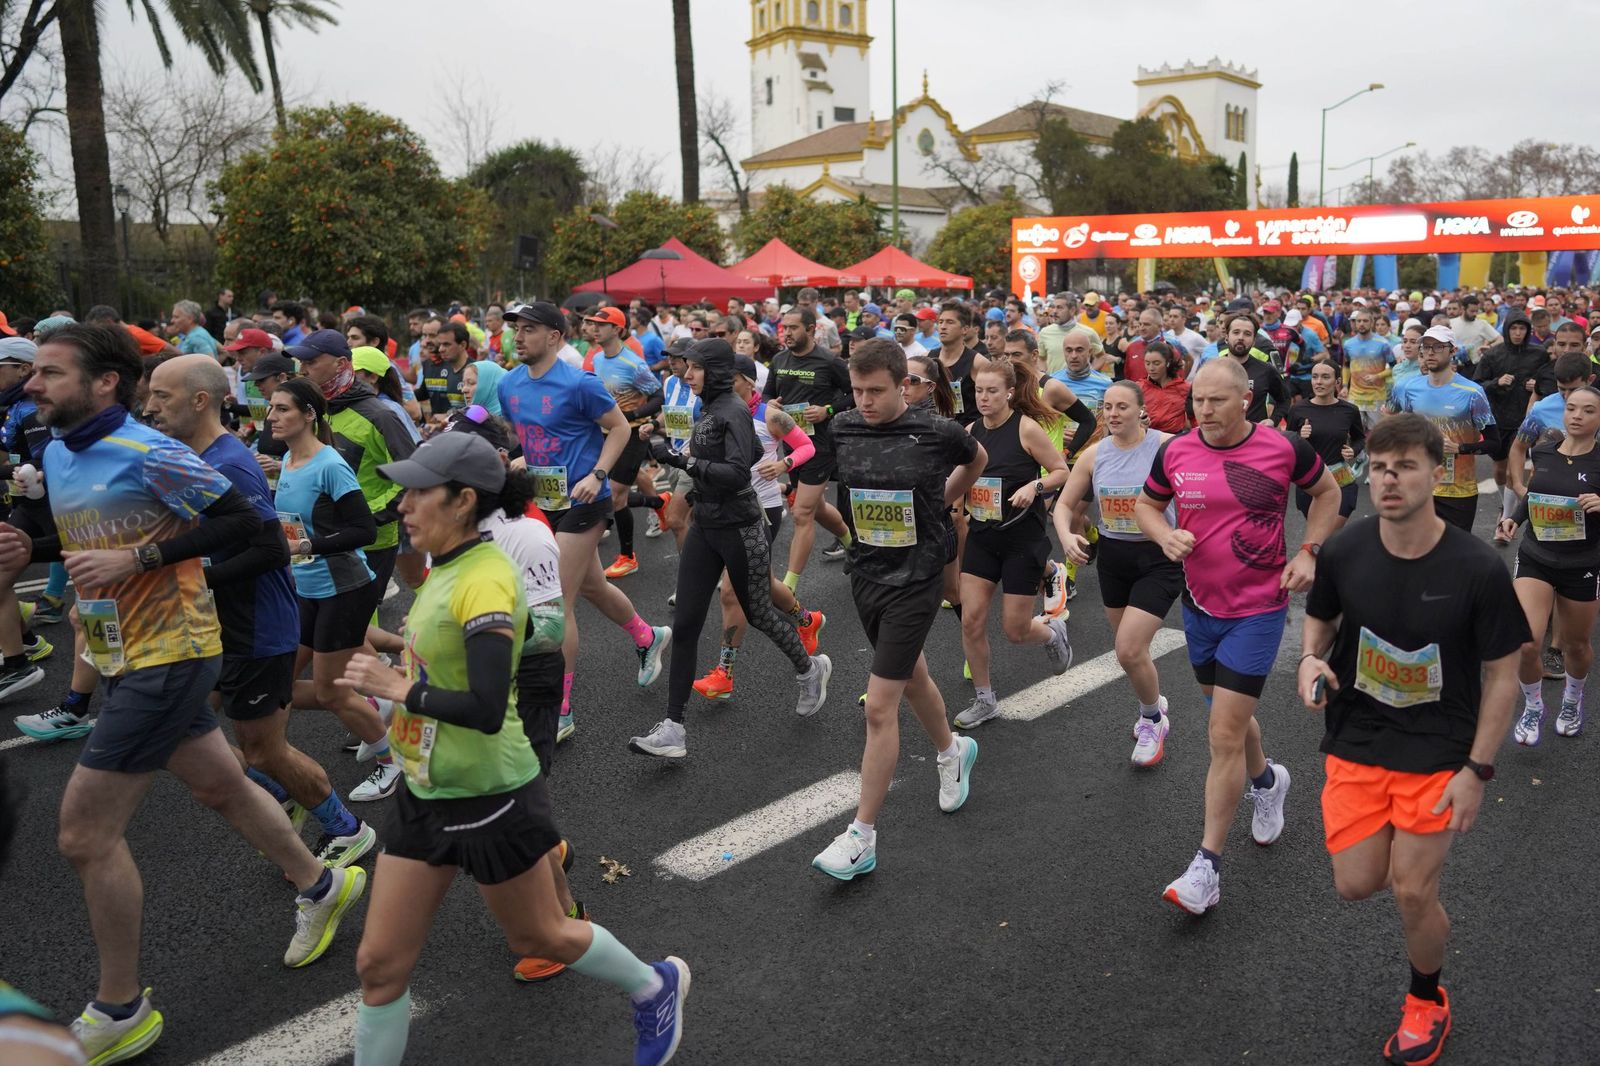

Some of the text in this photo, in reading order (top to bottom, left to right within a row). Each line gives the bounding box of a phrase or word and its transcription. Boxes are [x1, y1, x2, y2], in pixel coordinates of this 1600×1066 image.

[1434, 216, 1491, 235] HOKA
[1500, 227, 1544, 237] HYUNDAI
[789, 369, 815, 377] balance
[1577, 472, 1588, 482] K
[857, 503, 904, 522] 12288
[1531, 504, 1574, 522] 11694
[1365, 647, 1428, 684] 10933
